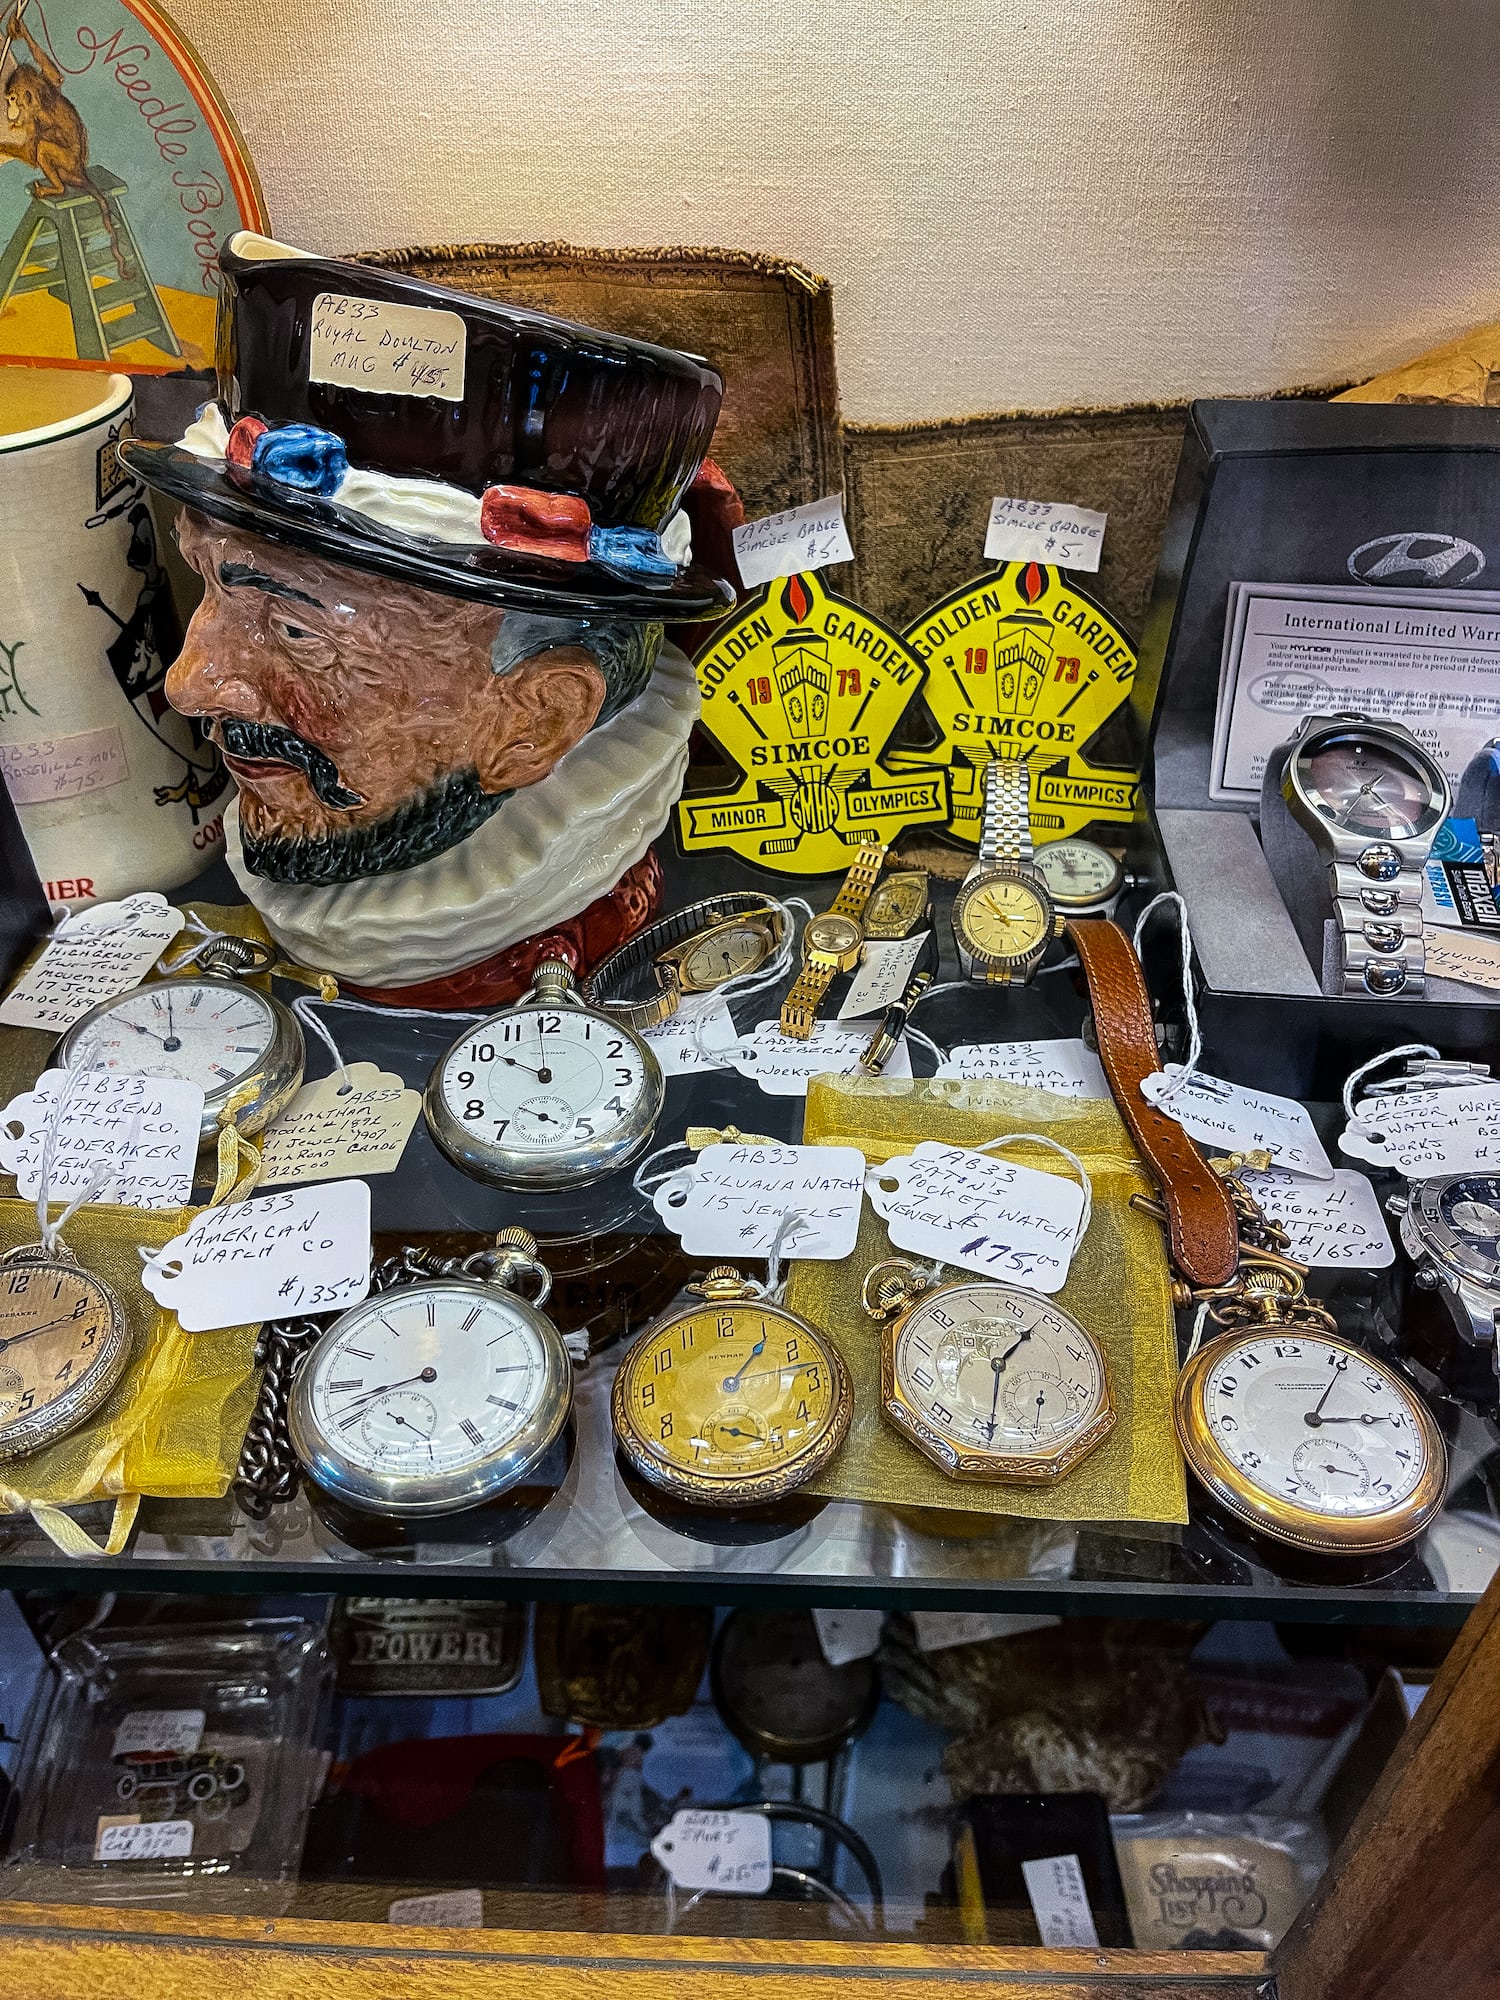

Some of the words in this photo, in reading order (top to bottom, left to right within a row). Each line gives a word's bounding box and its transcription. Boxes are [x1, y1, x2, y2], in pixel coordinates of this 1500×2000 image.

[77, 26, 197, 165] Needle
[172, 170, 224, 292] Book
[317, 295, 380, 321] AB33
[313, 318, 367, 346] ROYAL
[379, 329, 458, 355] DOULTON
[330, 351, 377, 373] MUG
[1000, 499, 1053, 516] AB33
[741, 509, 797, 539] AB33
[913, 590, 1002, 660] GOLDEN
[1053, 600, 1135, 685] GARDEN
[1283, 613, 1390, 634] International
[1394, 621, 1457, 639] Limited
[1462, 626, 1500, 641] Warr
[700, 616, 774, 701] GOLDEN
[824, 612, 916, 687] GARDEN
[964, 647, 988, 675] 19
[1054, 656, 1081, 685] 73
[747, 676, 772, 706] 19
[836, 669, 861, 697] 73
[952, 714, 1076, 742] SIMCOE
[751, 736, 870, 766] SIMCOE
[1044, 782, 1125, 805] OLYMPICS
[711, 808, 767, 829] MINOR
[853, 790, 929, 813] OLYMPICS
[1462, 869, 1500, 924] maxell
[120, 899, 171, 918] AB33
[504, 1024, 520, 1042] 11
[538, 1016, 561, 1034] 12
[585, 1023, 591, 1040] 1
[471, 1043, 495, 1063] 10
[606, 1040, 623, 1059] 2
[457, 1071, 475, 1089] 9
[614, 1068, 633, 1087] 3
[755, 1064, 820, 1076] WORKS
[76, 1073, 147, 1096] AB33
[105, 1099, 163, 1116] BEND
[463, 1099, 485, 1120] 8
[603, 1095, 626, 1117] 4
[1375, 1091, 1438, 1111] AB33
[1360, 1106, 1448, 1124] SECTOR
[1388, 1117, 1459, 1134] WATCH
[493, 1119, 511, 1141] 7
[574, 1117, 595, 1140] 5
[16, 1149, 39, 1164] 21
[729, 1148, 800, 1165] AB33
[939, 1150, 1017, 1184] AB33
[1399, 1151, 1446, 1166] GOOD
[48, 1171, 193, 1191] ADJUMENTS
[696, 1171, 794, 1192] SILVANA
[802, 1176, 864, 1192] WATCH
[908, 1158, 1008, 1197] EATON'S
[1238, 1169, 1294, 1185] B33
[207, 1194, 295, 1226] AB33
[703, 1194, 745, 1210] 15
[907, 1174, 1000, 1212] POCKET
[997, 1209, 1075, 1242] WATCH
[185, 1211, 320, 1248] AMERICAN
[192, 1244, 275, 1265] WATCH
[302, 1239, 334, 1252] CO
[681, 1326, 694, 1350] 11
[717, 1317, 734, 1338] 12
[654, 1348, 672, 1376] 10
[786, 1338, 798, 1363] 2
[806, 1367, 820, 1392] 3
[642, 1382, 655, 1408] 9
[796, 1399, 810, 1422] 4
[661, 1412, 673, 1440] 8
[368, 1631, 494, 1664] POWER
[1150, 1862, 1256, 1913] Shopping
